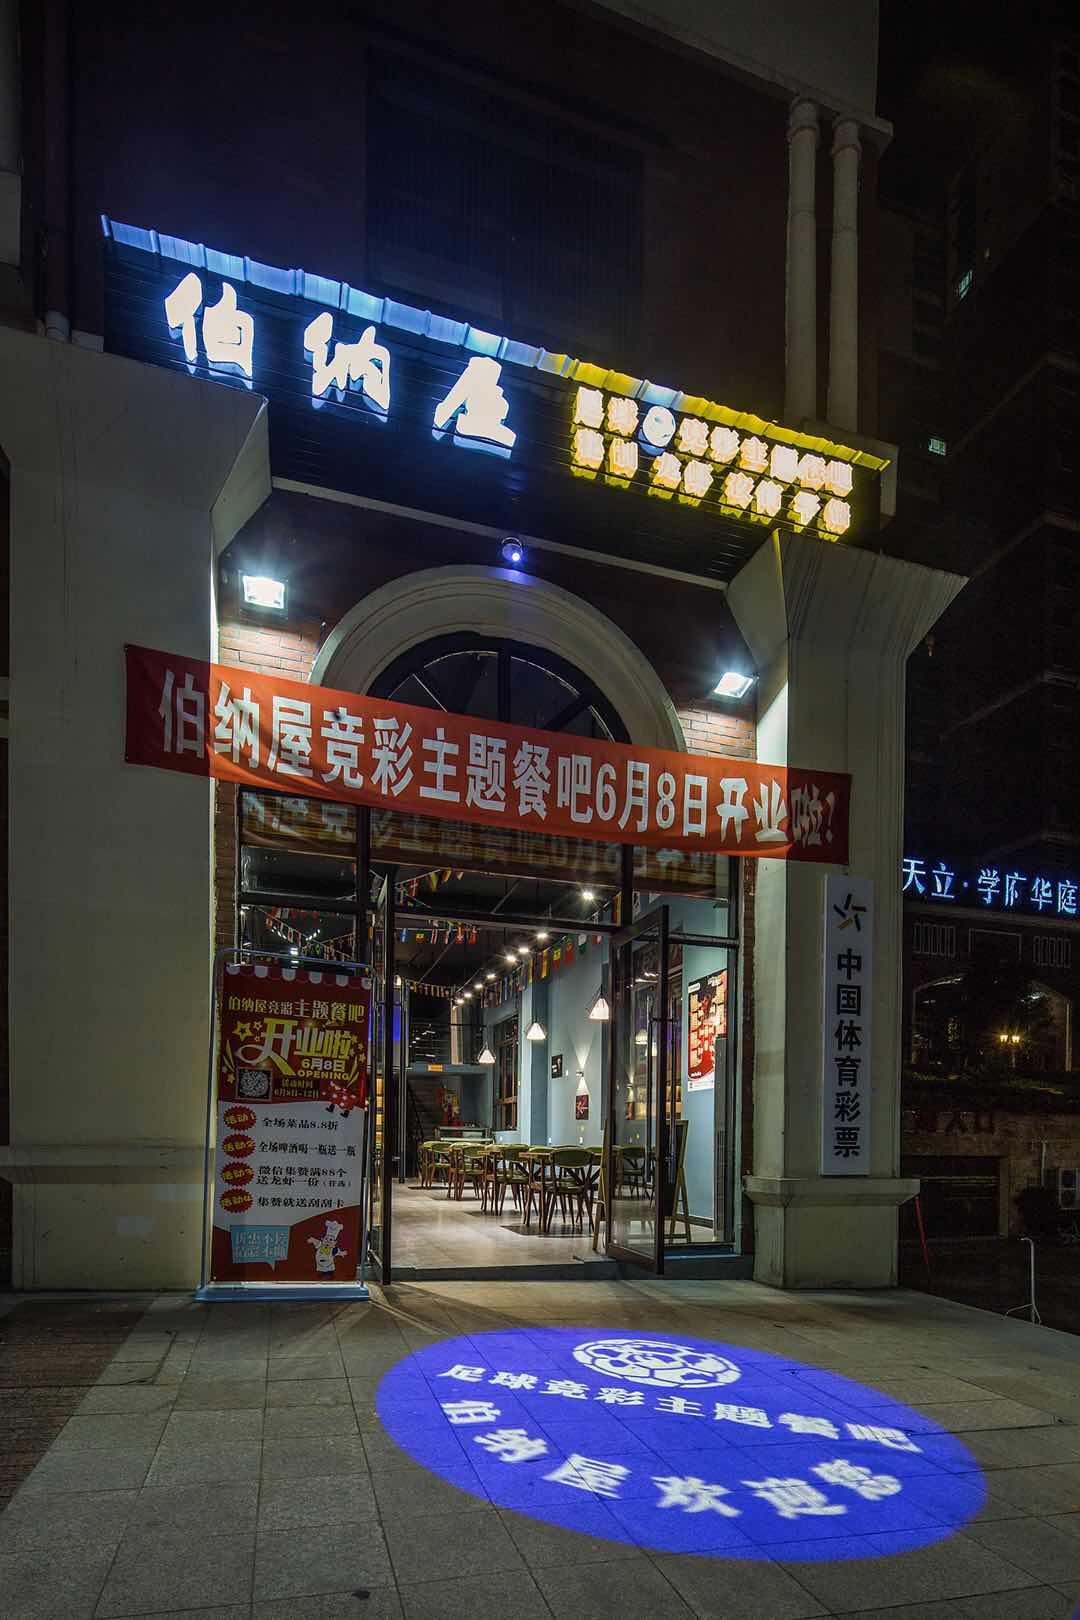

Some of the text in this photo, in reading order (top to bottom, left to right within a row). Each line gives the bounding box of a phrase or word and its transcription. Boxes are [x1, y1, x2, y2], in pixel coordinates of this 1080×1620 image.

[165, 272, 517, 448] 伯纳屋
[228, 996, 365, 1024] 伯纳屋竞彩主题餐吧
[235, 1017, 353, 1076] 开业啦
[834, 948, 863, 1158] 中国体育彩票
[297, 1070, 351, 1081] OPENING
[301, 1058, 346, 1073] 6月8日
[263, 1117, 338, 1131] 全场菜品8.8折
[258, 1141, 357, 1157] 全场啤酒喝一瓶送一瓶
[258, 1165, 348, 1178] 微信集赞满88个
[258, 1195, 345, 1209] 集赞就送刮刮卡
[436, 1363, 925, 1455] 足球竞彩主题餐吧
[441, 1399, 903, 1519] 伯纳屋欢迎您
